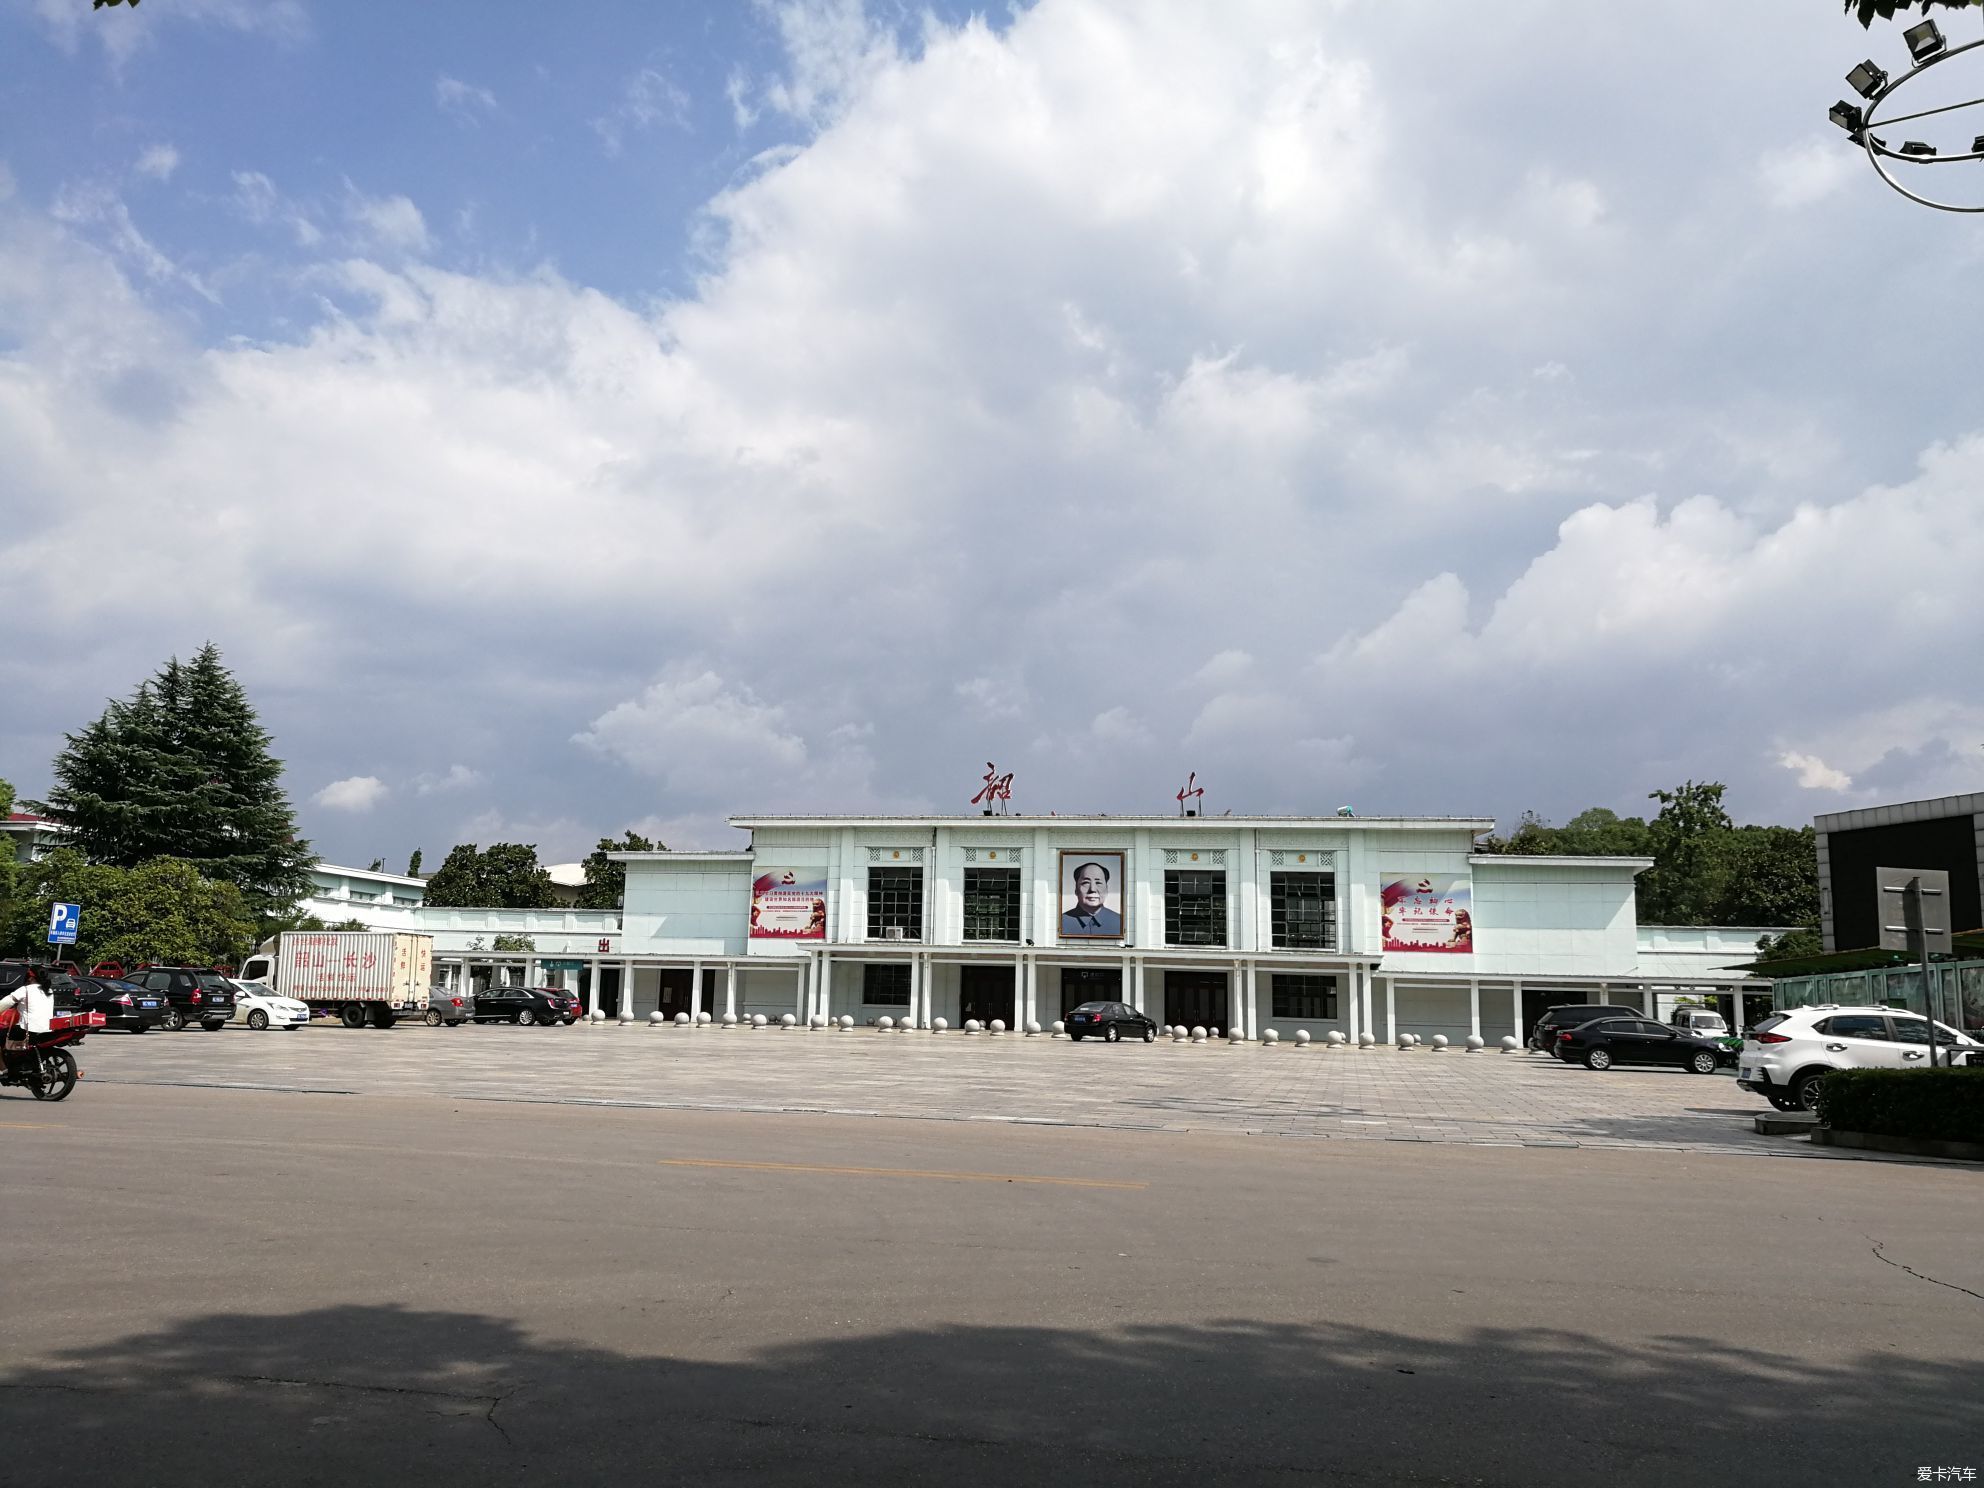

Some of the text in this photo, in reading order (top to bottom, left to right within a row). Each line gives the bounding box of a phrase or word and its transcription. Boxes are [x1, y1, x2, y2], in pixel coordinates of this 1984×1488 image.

[1397, 896, 1454, 905] 不忘初心
[52, 905, 68, 930] P
[1398, 907, 1454, 916] 牢记使命
[598, 937, 610, 952] 出
